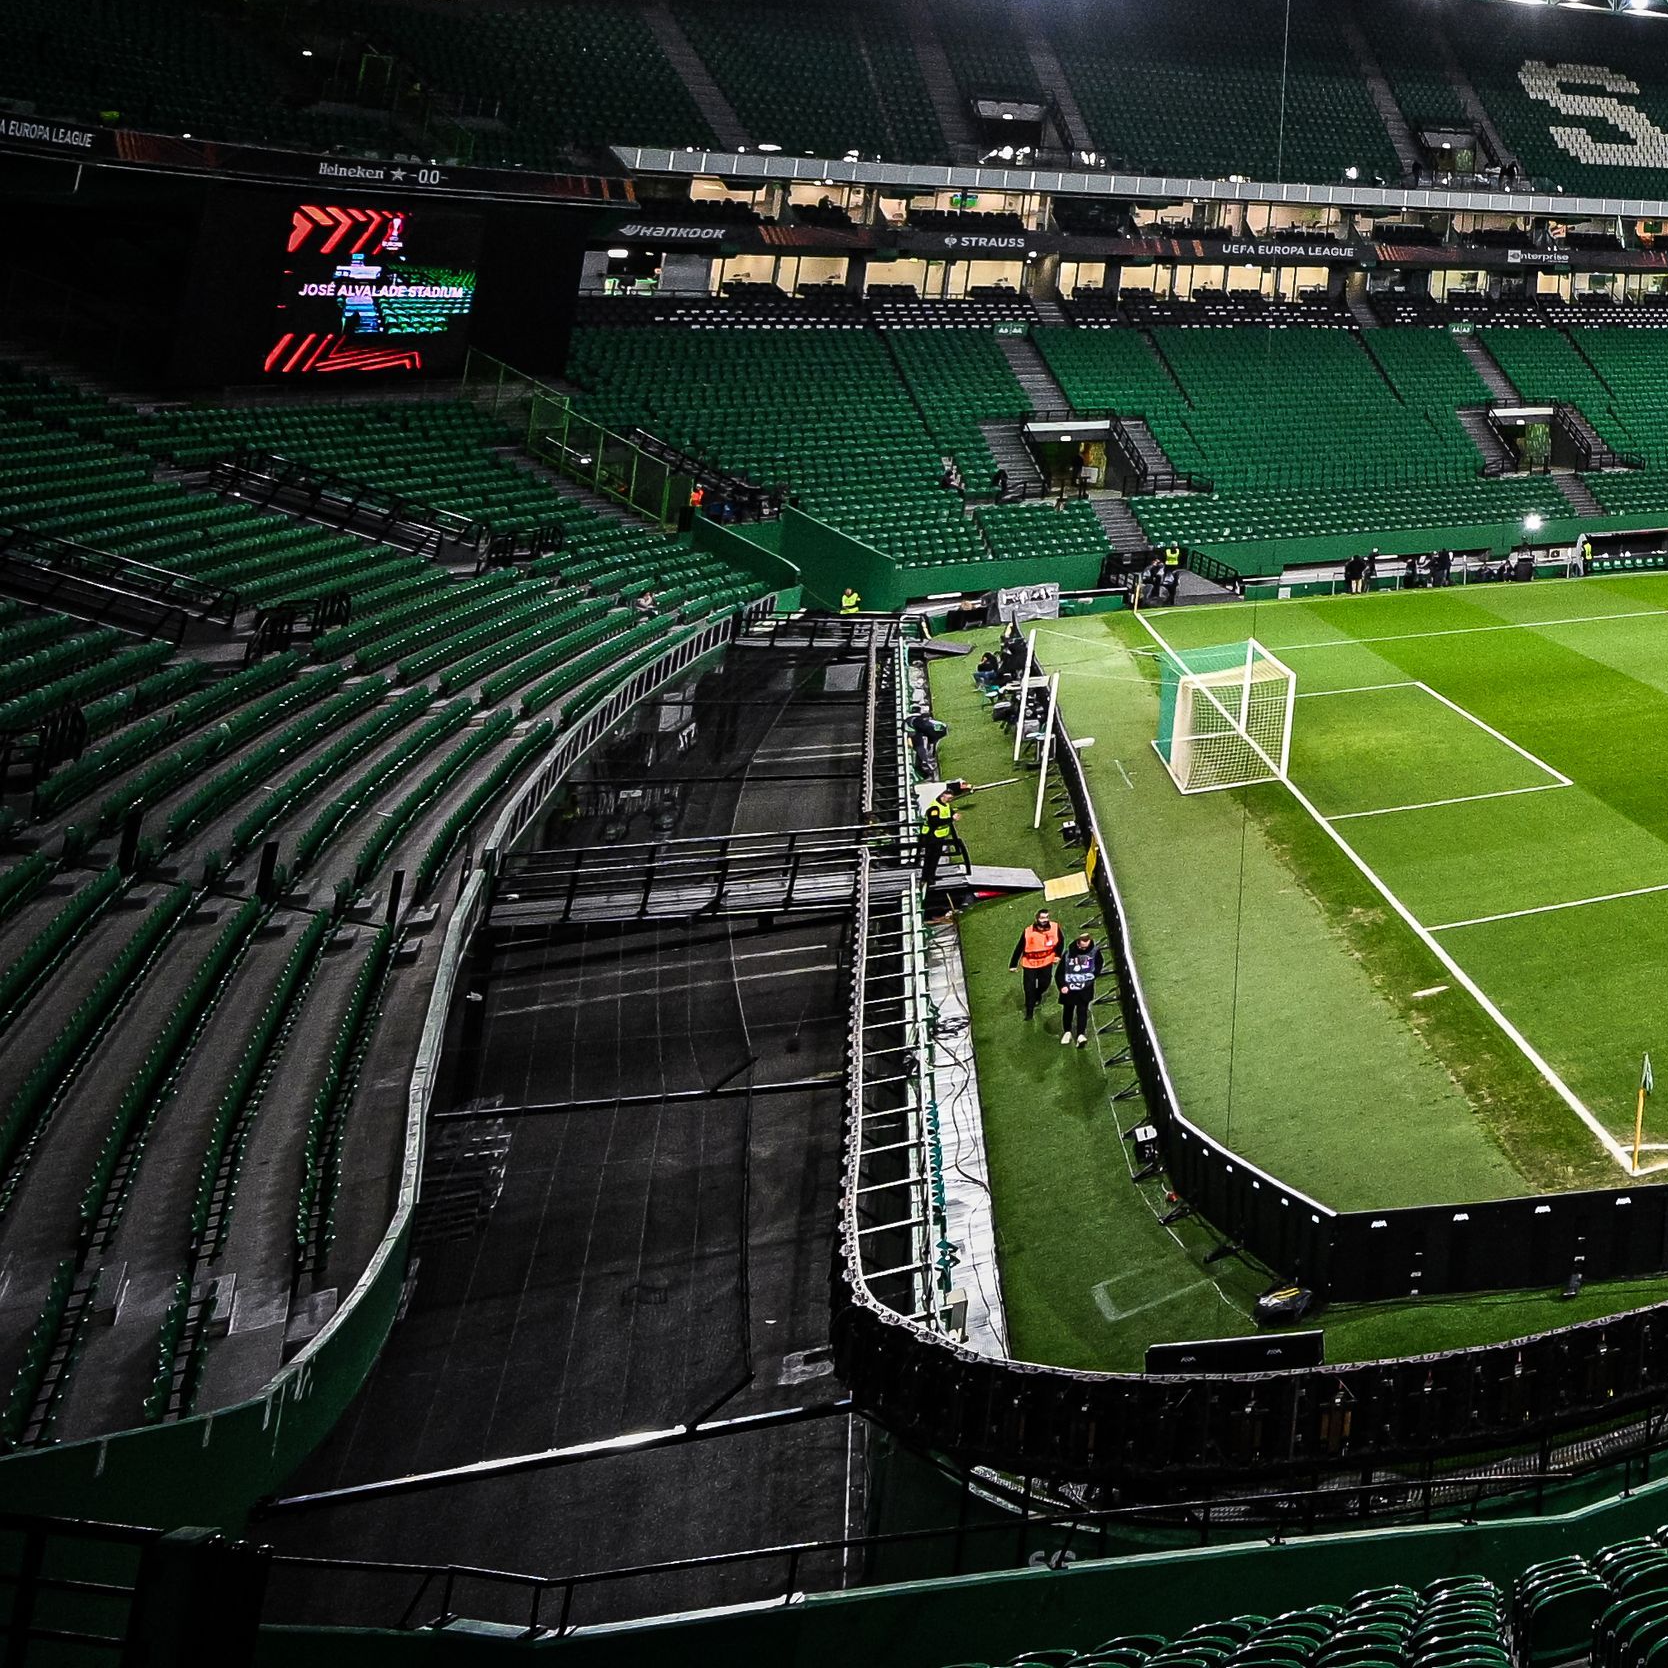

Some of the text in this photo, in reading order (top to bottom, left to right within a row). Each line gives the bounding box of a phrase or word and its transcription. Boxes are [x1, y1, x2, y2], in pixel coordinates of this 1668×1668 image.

[9, 120, 50, 141] EUROPA
[52, 128, 93, 147] LEAGUE
[319, 163, 384, 179] Heineken
[960, 237, 1025, 247] STRAUSS
[1222, 244, 1354, 257] UEFA EUROPA LEAGUE
[299, 282, 463, 298] JOSÉ ALVALADE STADIUM
